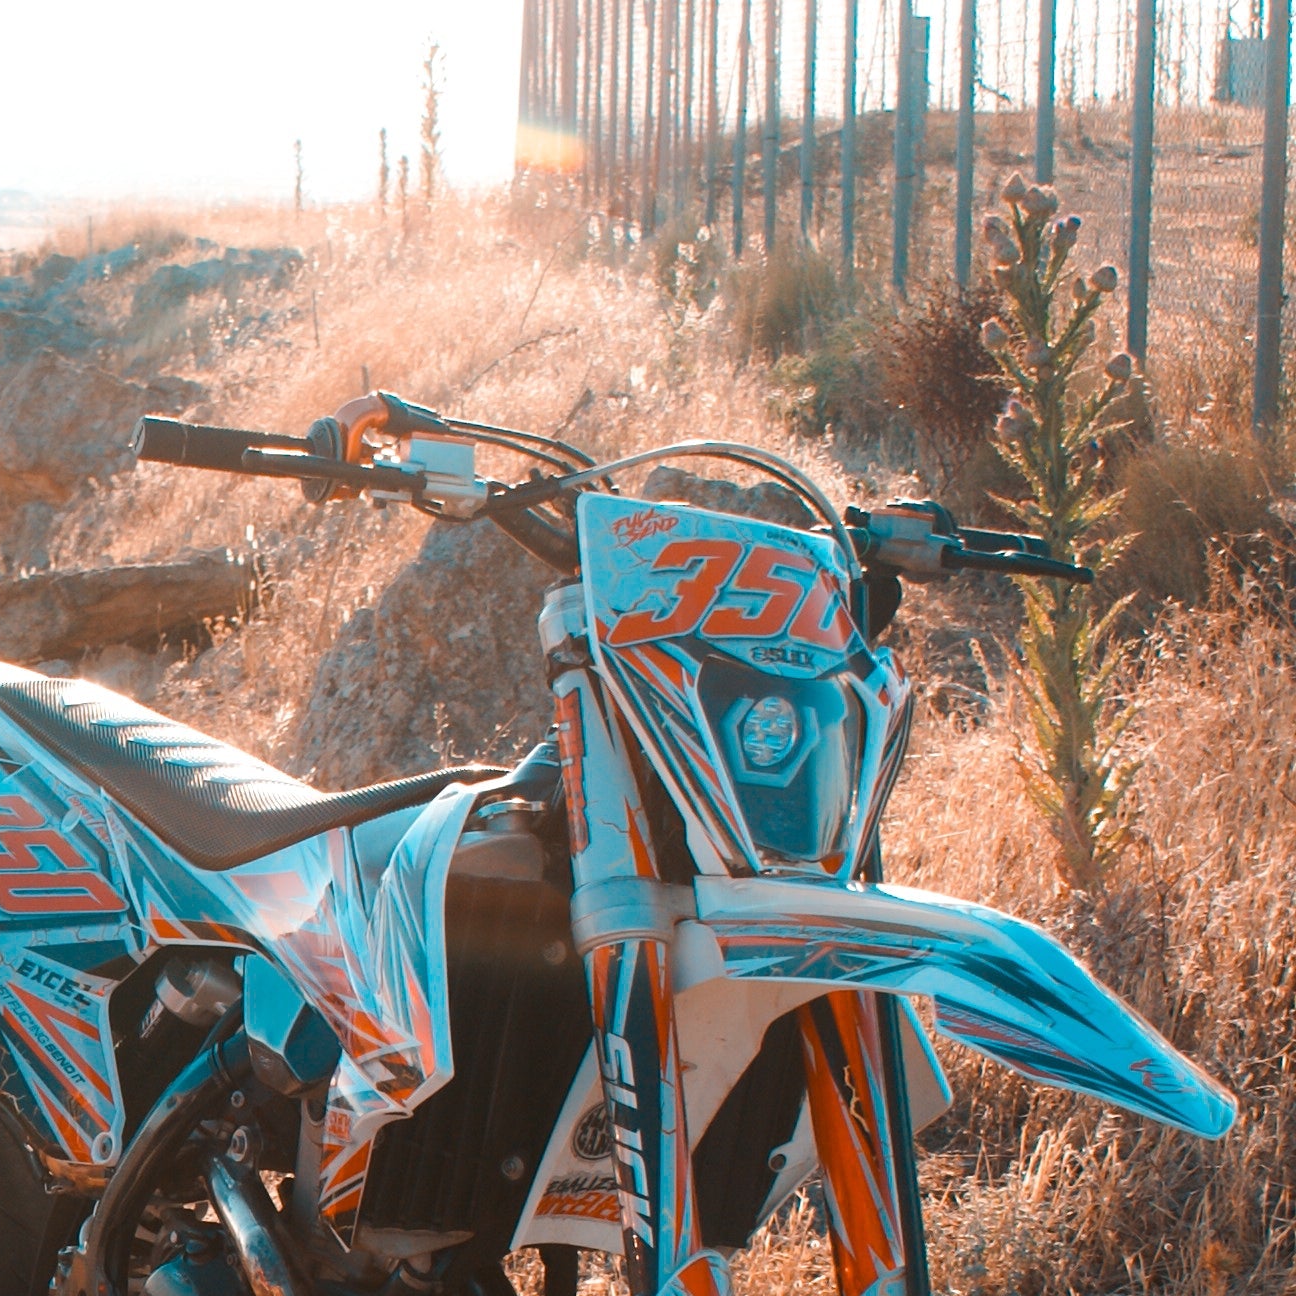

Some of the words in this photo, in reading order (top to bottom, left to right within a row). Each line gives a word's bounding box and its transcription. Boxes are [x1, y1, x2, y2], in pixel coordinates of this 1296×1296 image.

[607, 539, 854, 653] 350
[16, 958, 94, 1006] EXCEL
[604, 1033, 655, 1248] SLICK
